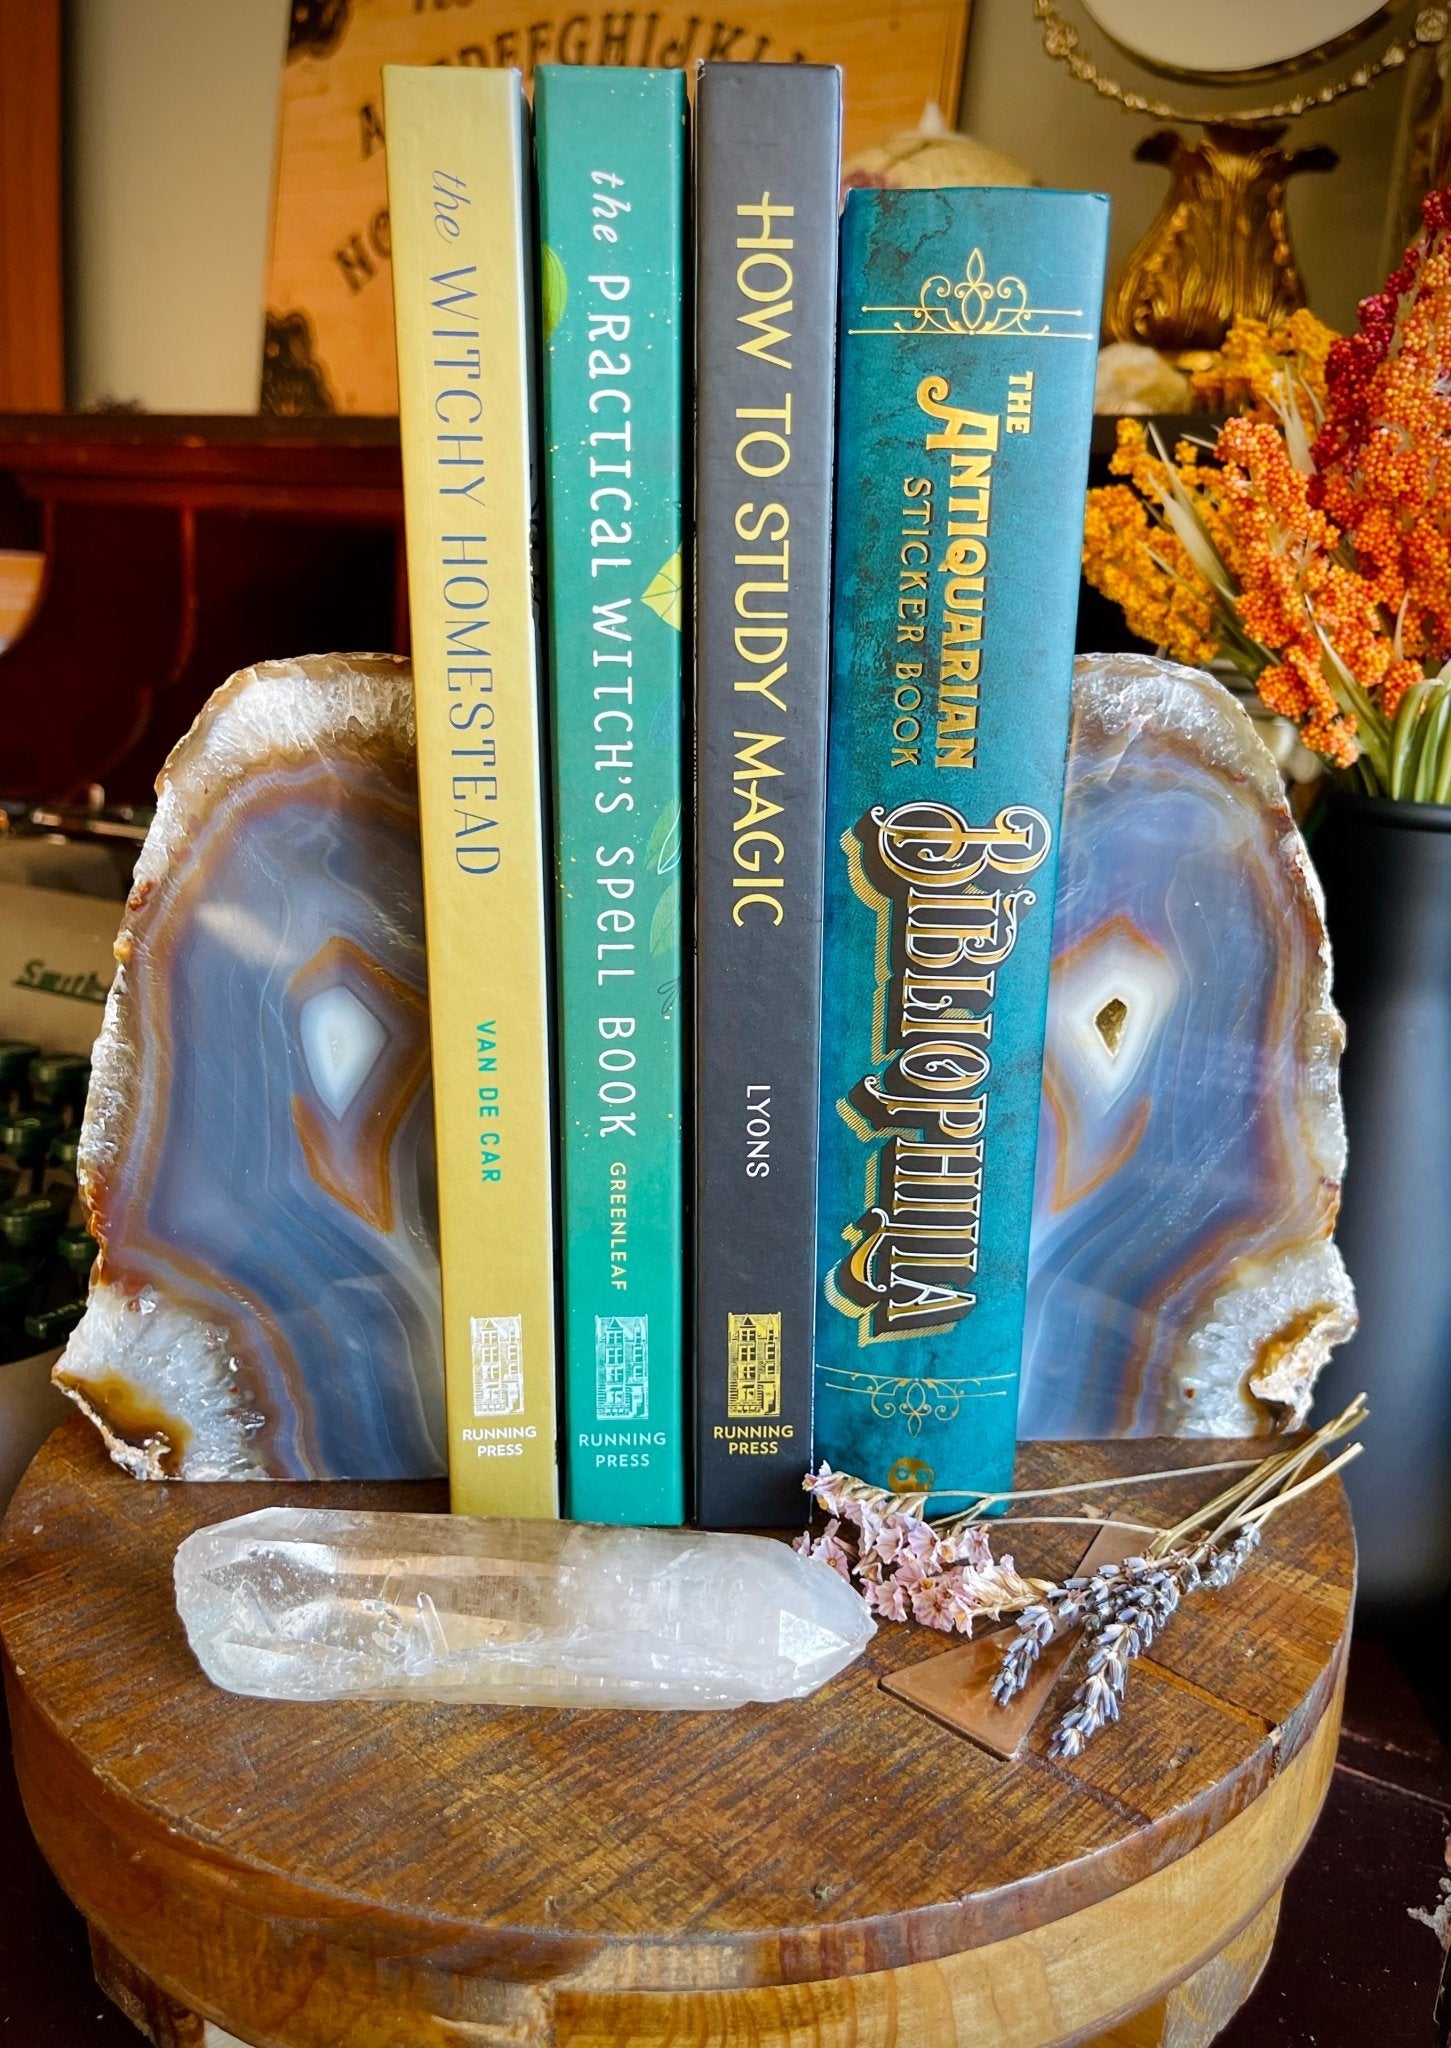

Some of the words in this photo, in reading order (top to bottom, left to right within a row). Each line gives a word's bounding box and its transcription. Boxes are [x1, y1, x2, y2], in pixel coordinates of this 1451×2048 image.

[431, 170, 472, 245] the
[590, 170, 632, 244] the
[735, 191, 795, 370] HOW
[429, 265, 487, 507] WITCHY
[1006, 370, 1034, 434] THE
[735, 392, 792, 478] TO
[896, 477, 932, 646] STICKER
[916, 375, 1000, 770] ANTIQUARIAN
[733, 502, 790, 712] STUDY
[441, 535, 501, 876] HOMESTEAD
[590, 597, 635, 814] WITCH'S
[890, 660, 924, 768] BOOK
[732, 730, 786, 927] MAGIC
[475, 1019, 498, 1073] VAN
[597, 1016, 637, 1139] BOOK
[850, 800, 1052, 1323] BIBLIOPHILIA
[478, 1087, 501, 1119] DE
[745, 1084, 771, 1179] LYONS
[480, 1131, 502, 1184] CAR
[609, 1162, 627, 1292] GREENLEAF
[462, 1425, 537, 1441] RUNNING
[477, 1442, 524, 1457] PRESS
[579, 1431, 667, 1448] RUNNING
[595, 1452, 650, 1468] PRESS
[713, 1424, 794, 1440] RUNNING
[728, 1441, 779, 1456] PRESS
